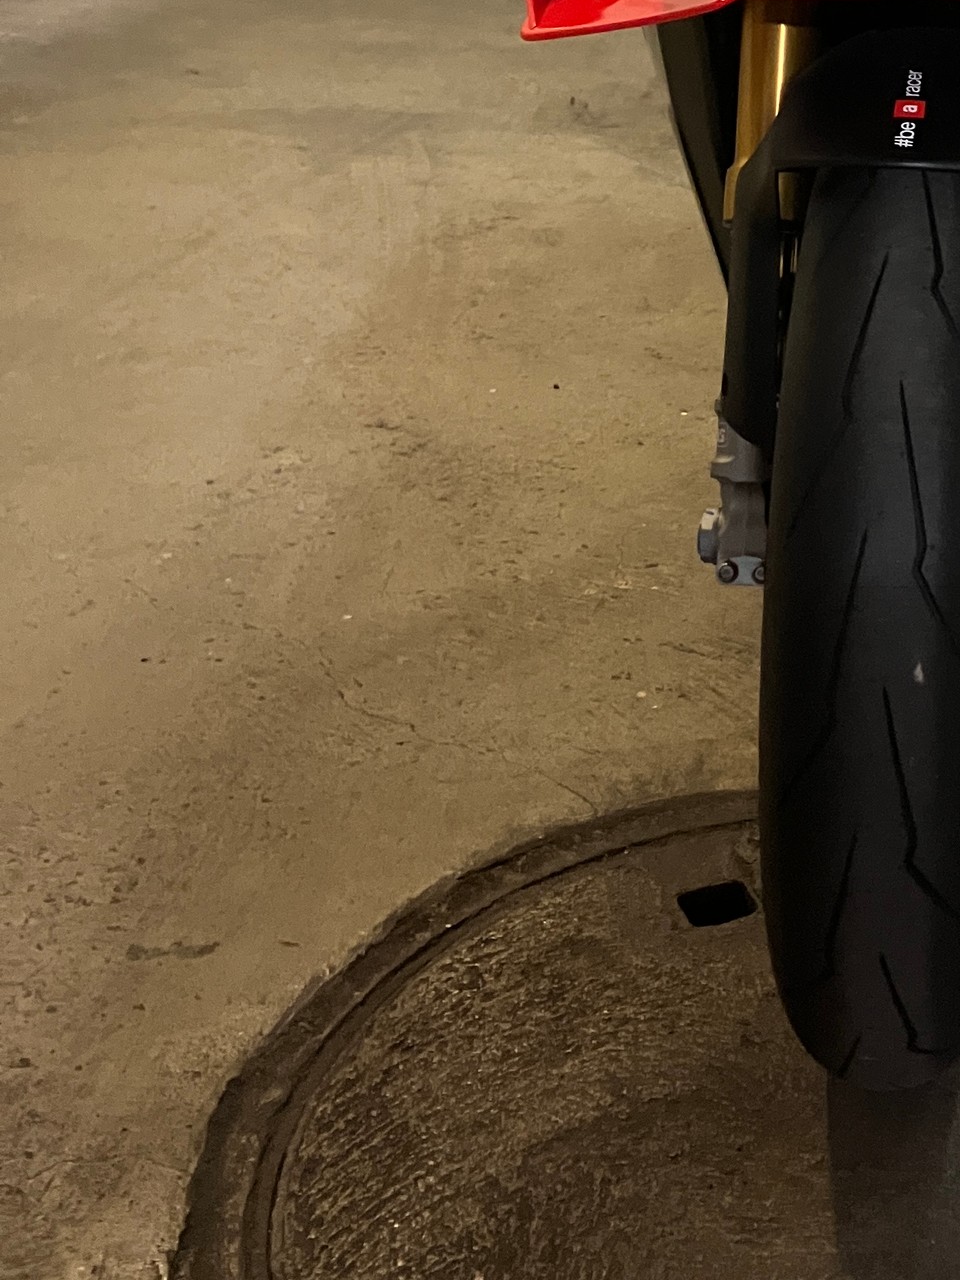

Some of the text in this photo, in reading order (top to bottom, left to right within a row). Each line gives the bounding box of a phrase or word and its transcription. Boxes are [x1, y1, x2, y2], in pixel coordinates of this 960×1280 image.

[894, 69, 923, 148] #be a racer
